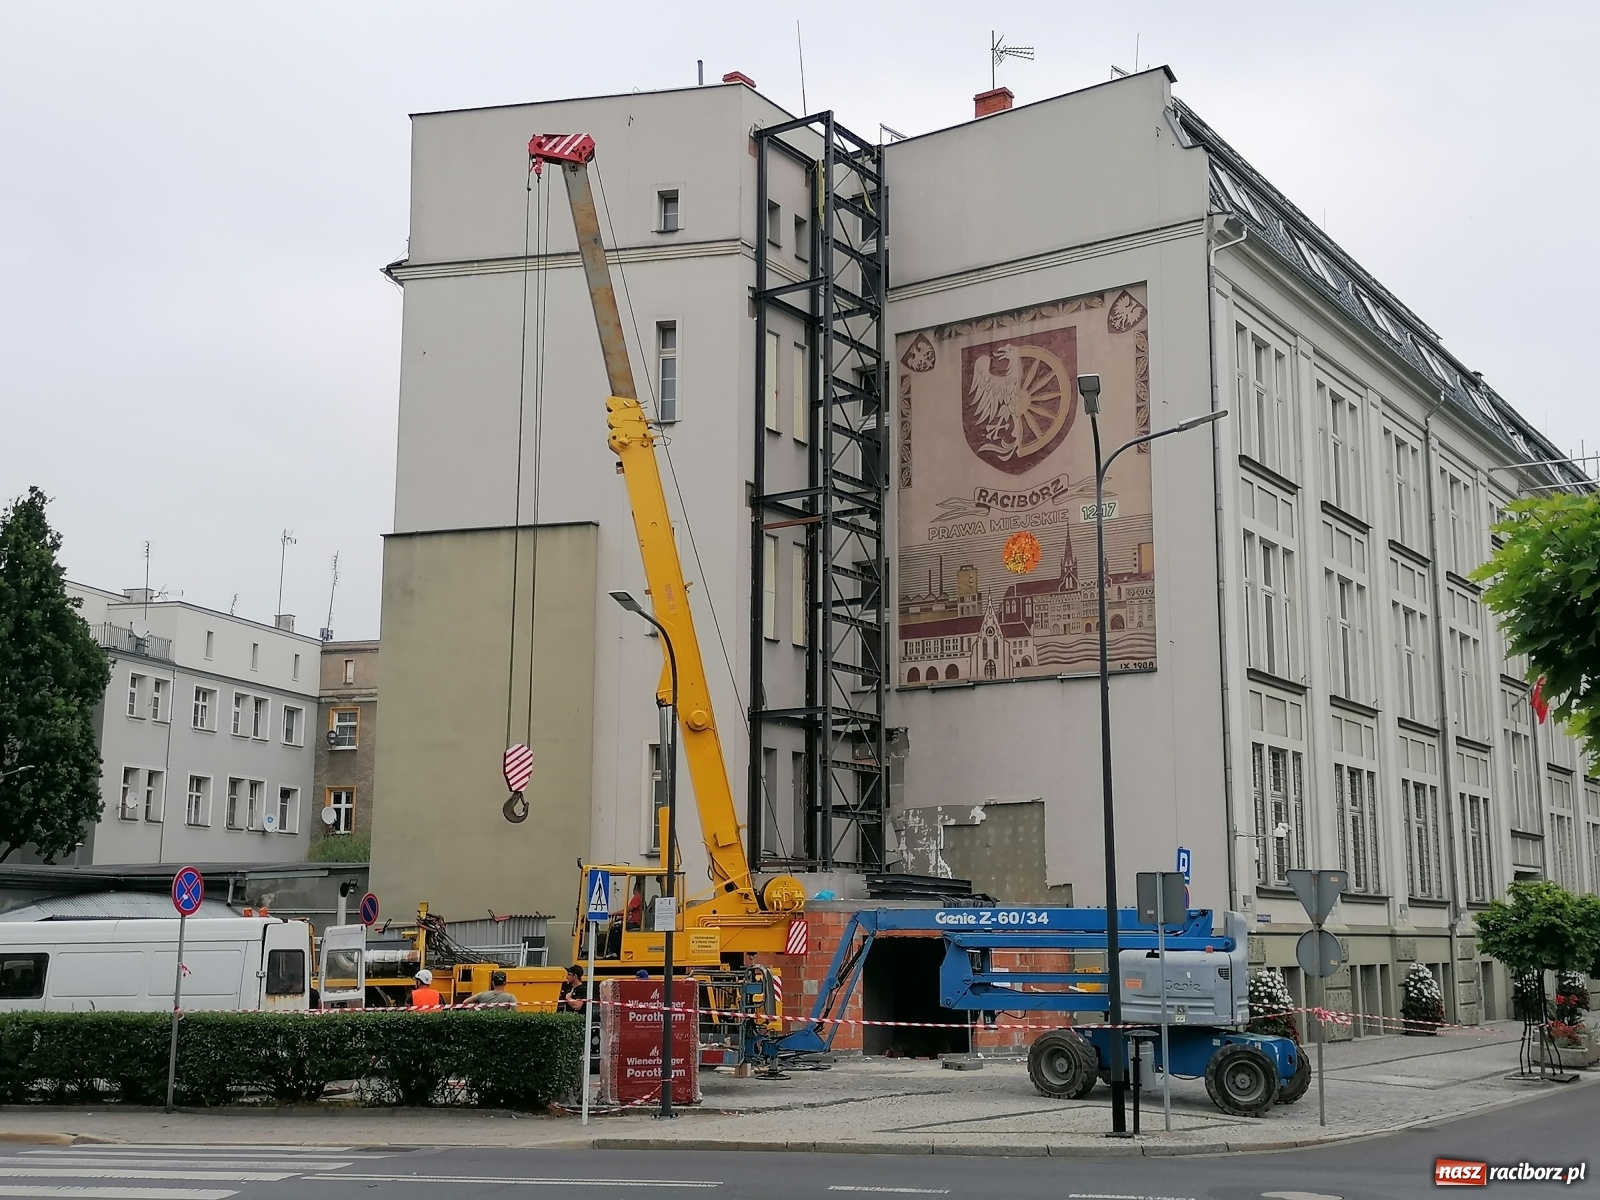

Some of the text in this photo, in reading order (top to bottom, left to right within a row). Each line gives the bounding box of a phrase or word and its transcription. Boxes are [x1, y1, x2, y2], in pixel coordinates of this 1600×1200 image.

[976, 478, 1064, 508] RACIBÓRZ
[928, 502, 1117, 541] PRAWA MIEJSKIE 1217
[935, 911, 1049, 925] Genie Z-60/34
[1164, 979, 1201, 991] Genie
[628, 1011, 686, 1021] Porothrm
[626, 1057, 685, 1066] Wienerbger
[626, 1067, 686, 1078] Porothrm
